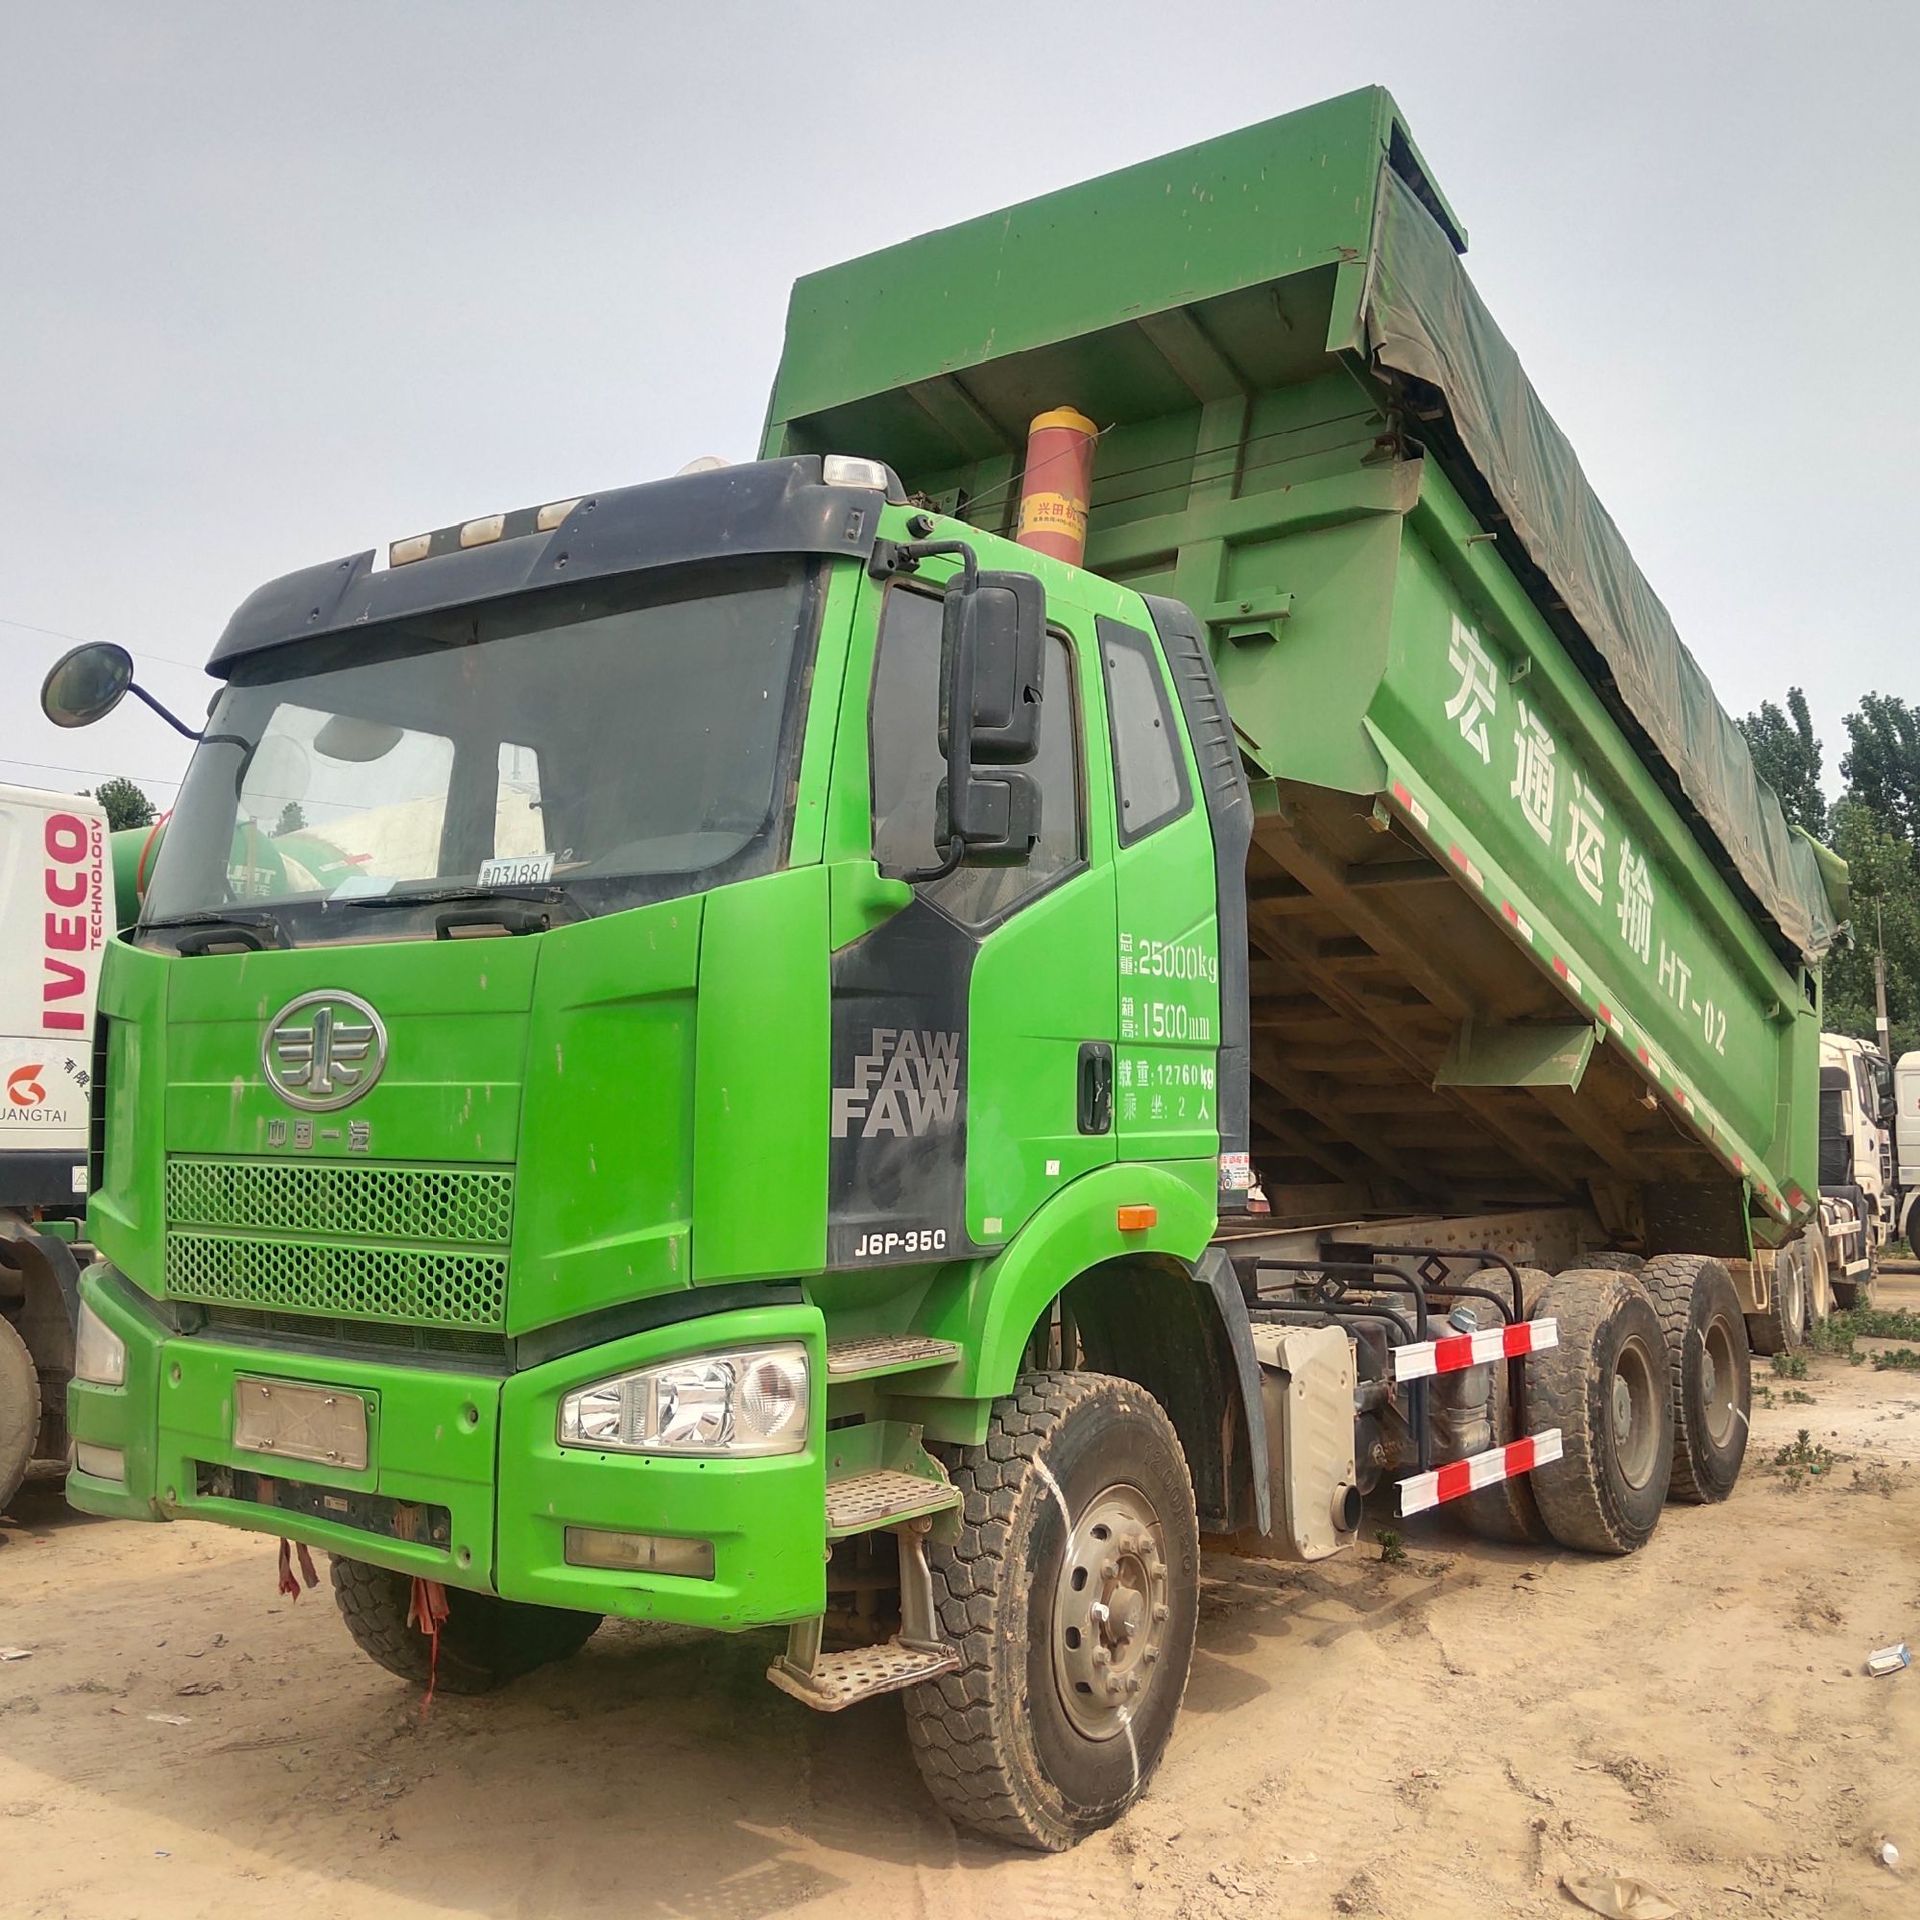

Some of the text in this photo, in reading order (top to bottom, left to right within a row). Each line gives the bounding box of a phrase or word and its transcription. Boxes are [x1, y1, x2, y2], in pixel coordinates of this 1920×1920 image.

[1444, 612, 1726, 1056] 宏通运输 HT-02
[90, 818, 103, 951] TECHNOLOGY
[42, 813, 89, 1031] IVECO
[1139, 938, 1217, 984] 25000kg
[1143, 1002, 1210, 1041] 1500mm
[872, 1027, 960, 1065] FAW
[854, 1055, 960, 1098] FAW
[831, 1087, 960, 1138] FAW
[268, 1118, 370, 1152] 中国一汽
[855, 1229, 946, 1257] J6P-350
